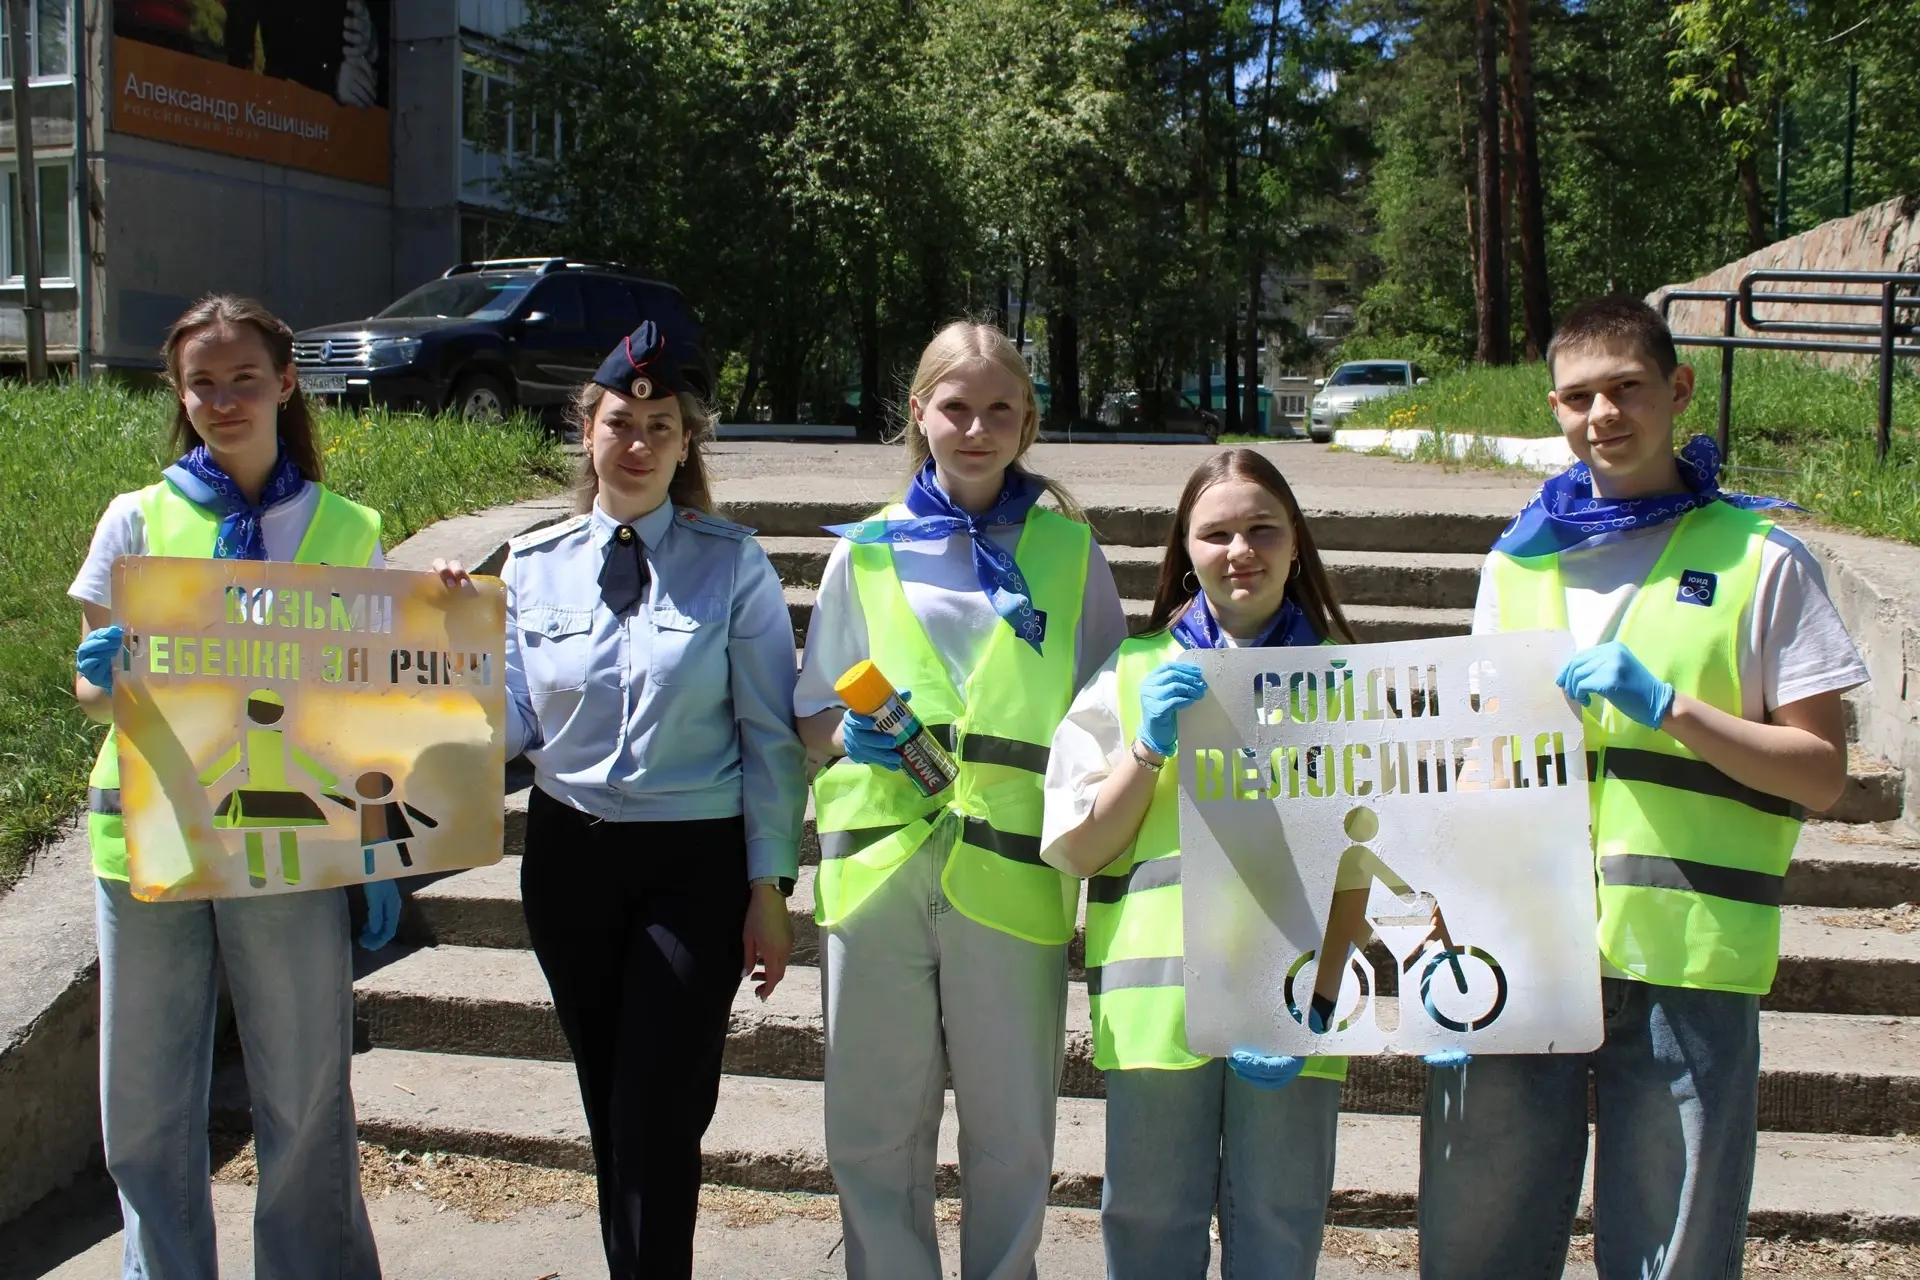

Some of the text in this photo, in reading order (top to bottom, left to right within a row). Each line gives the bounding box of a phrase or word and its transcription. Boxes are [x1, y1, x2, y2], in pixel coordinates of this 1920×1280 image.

[124, 71, 330, 141] Александр Кашицын
[1688, 576, 1708, 586] ЮИД
[226, 585, 392, 634] ВОЗЬМИ
[123, 634, 492, 686] РЕБЕНКА ЗА РУКУ
[1253, 658, 1498, 725] СОЙДИ С
[875, 705, 906, 733] KUDO
[904, 743, 941, 788] ЭМАЛЬ
[1195, 731, 1569, 801] ВЕЛОСИПЕДА
